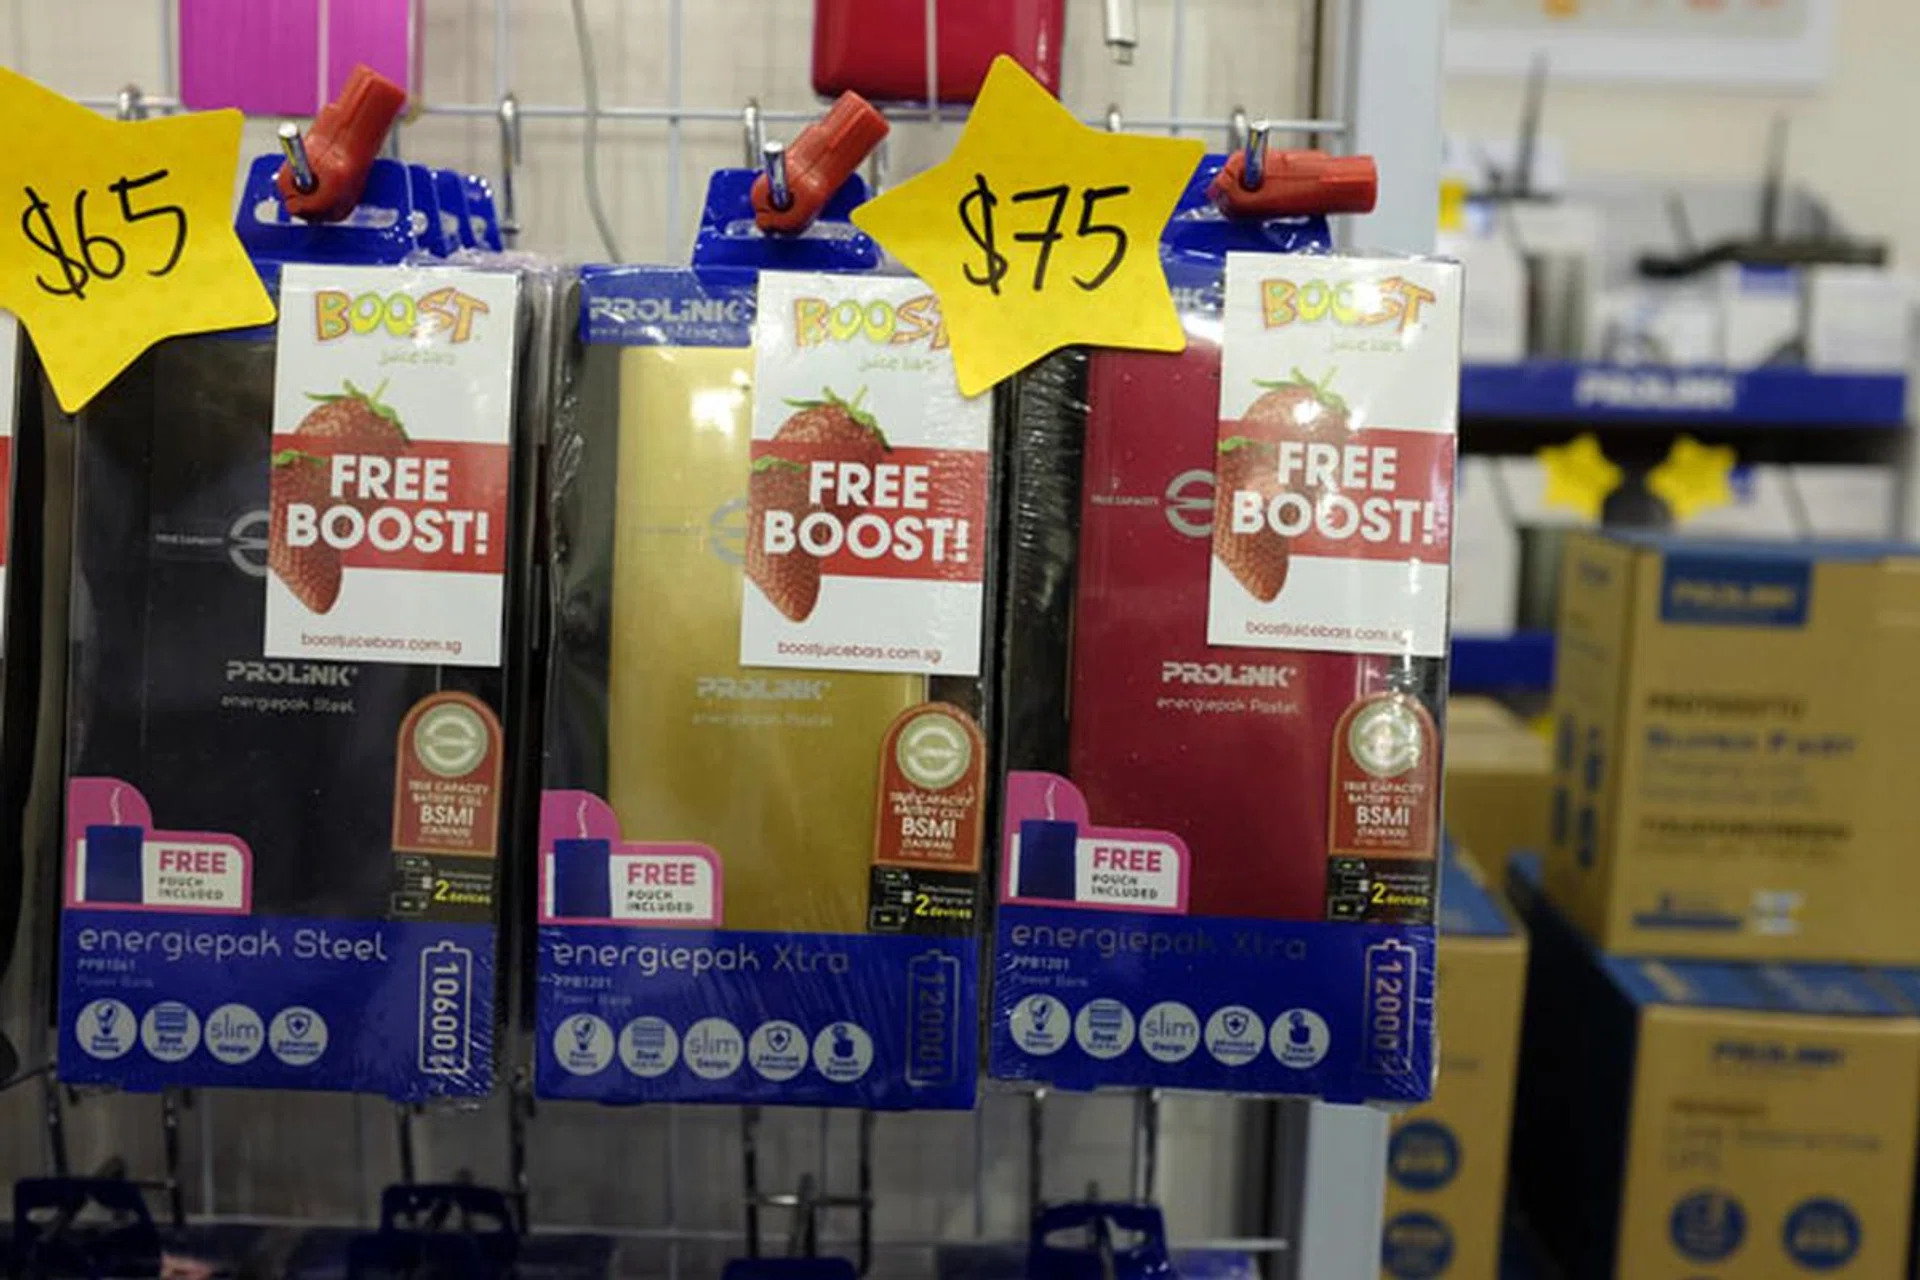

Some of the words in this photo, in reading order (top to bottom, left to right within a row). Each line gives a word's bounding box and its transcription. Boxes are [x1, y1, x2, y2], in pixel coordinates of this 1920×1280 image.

[21, 169, 188, 299] $65
[958, 174, 1129, 295] $75
[315, 287, 490, 344] BOOST
[331, 453, 450, 501] FREE
[1277, 441, 1398, 491] FREE
[808, 460, 930, 510] FREE
[286, 503, 488, 556] BOOST!
[1231, 490, 1435, 545] BOOST!
[762, 509, 970, 563] BOOST!
[301, 633, 462, 655] boostjuicebars.com.sg
[777, 641, 942, 665] boostjuicebars.com.sg
[420, 804, 475, 826] BSMI
[901, 816, 956, 838] BSMI
[1356, 805, 1409, 826] BSMI
[159, 849, 227, 874] FREE
[1093, 846, 1162, 873] FREE
[628, 863, 696, 886] FREE
[434, 879, 450, 901] 2
[1371, 881, 1387, 904] 2
[914, 893, 930, 916] 2
[78, 928, 282, 962] energiepak
[293, 928, 388, 962] Steel
[1011, 922, 1217, 958] energiepak
[1231, 929, 1307, 959] Xtra
[553, 942, 760, 978] energiepak
[773, 947, 850, 974] Xtra
[210, 1013, 259, 1040] slim
[1145, 1011, 1195, 1038] slim
[689, 1027, 738, 1055] slim
